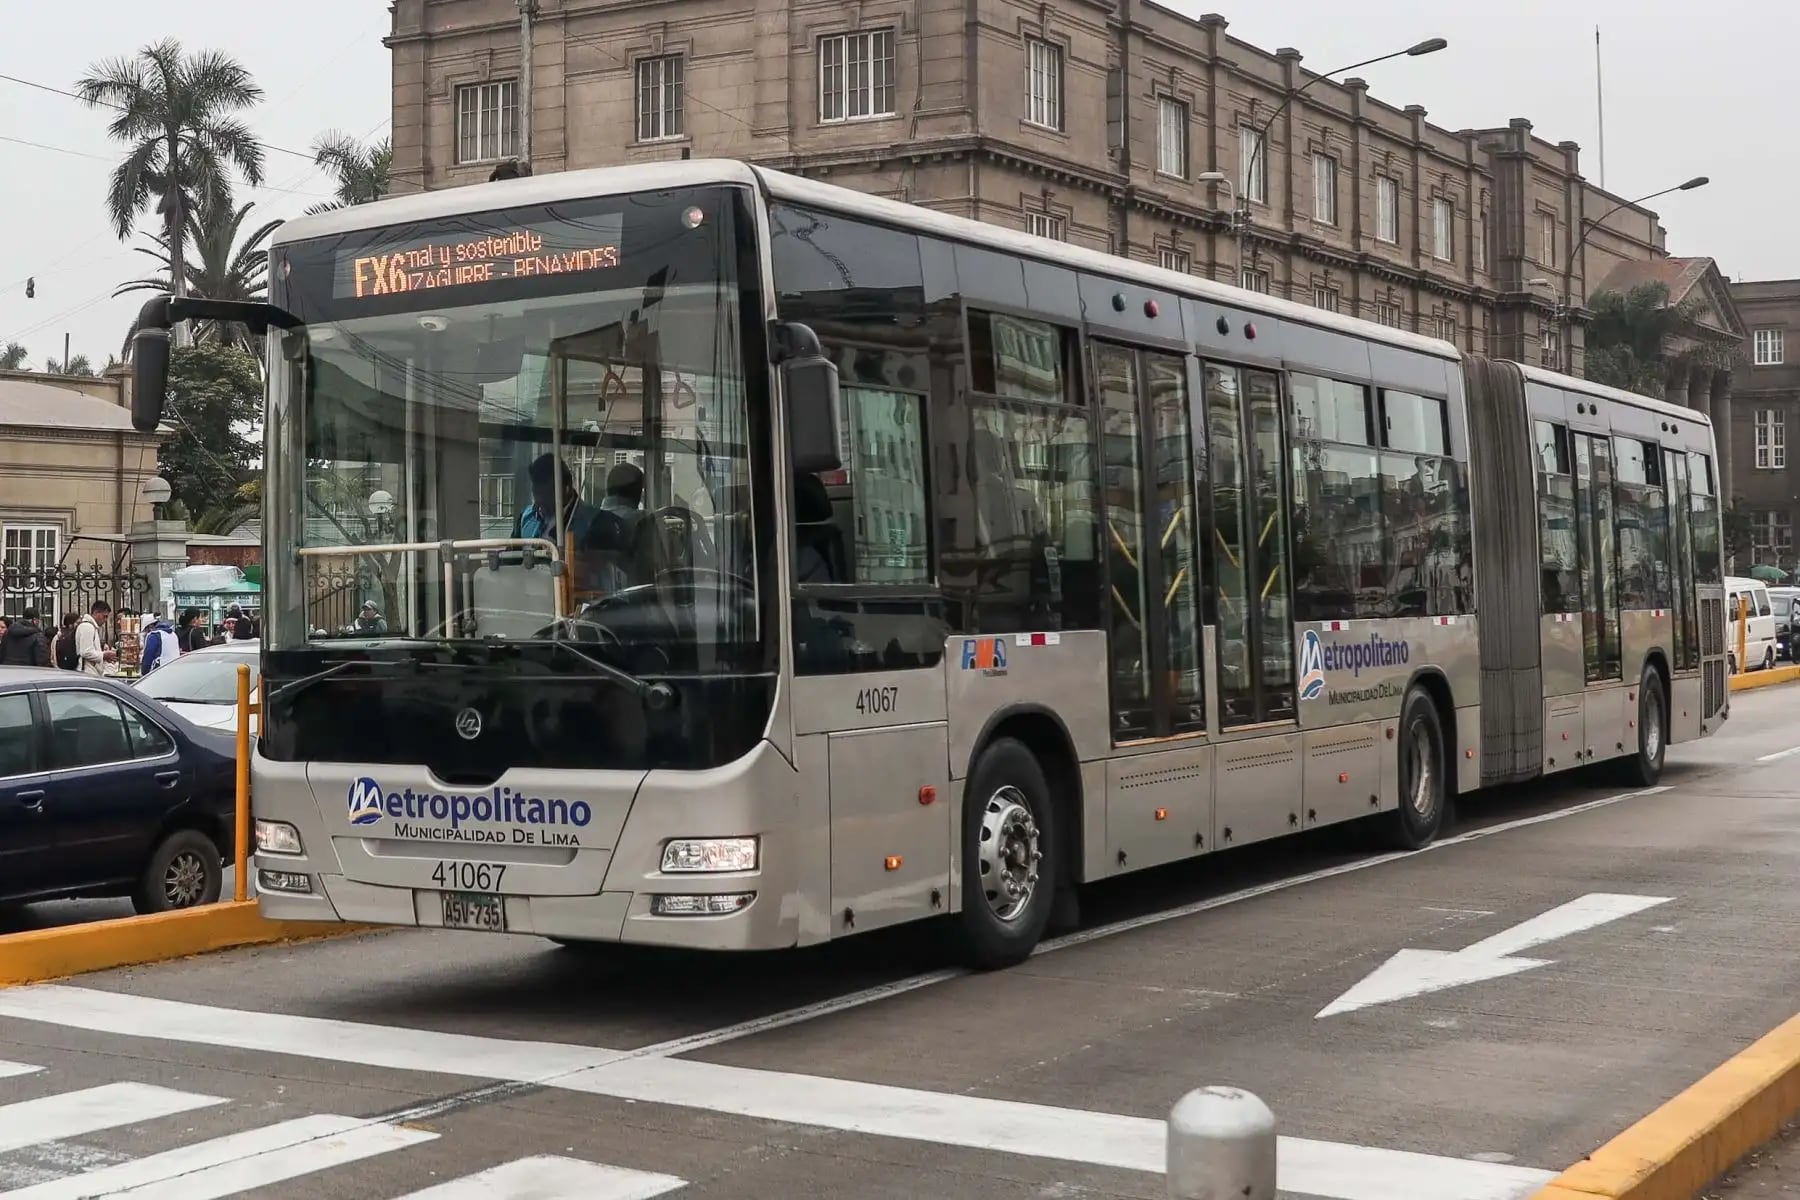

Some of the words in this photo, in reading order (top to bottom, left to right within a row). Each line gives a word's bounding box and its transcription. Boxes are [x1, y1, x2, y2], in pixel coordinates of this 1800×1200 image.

[441, 247, 451, 269] y
[456, 230, 542, 262] sostenible
[514, 246, 617, 278] BENAVIDES
[1299, 630, 1409, 682] Metropolitano
[855, 687, 898, 714] 41067
[348, 777, 592, 828] Metropolitano
[394, 823, 506, 843] MUNICIPALIDAD
[541, 829, 580, 846] LIMA
[432, 861, 507, 892] 41067
[445, 901, 500, 927] A5V-735
